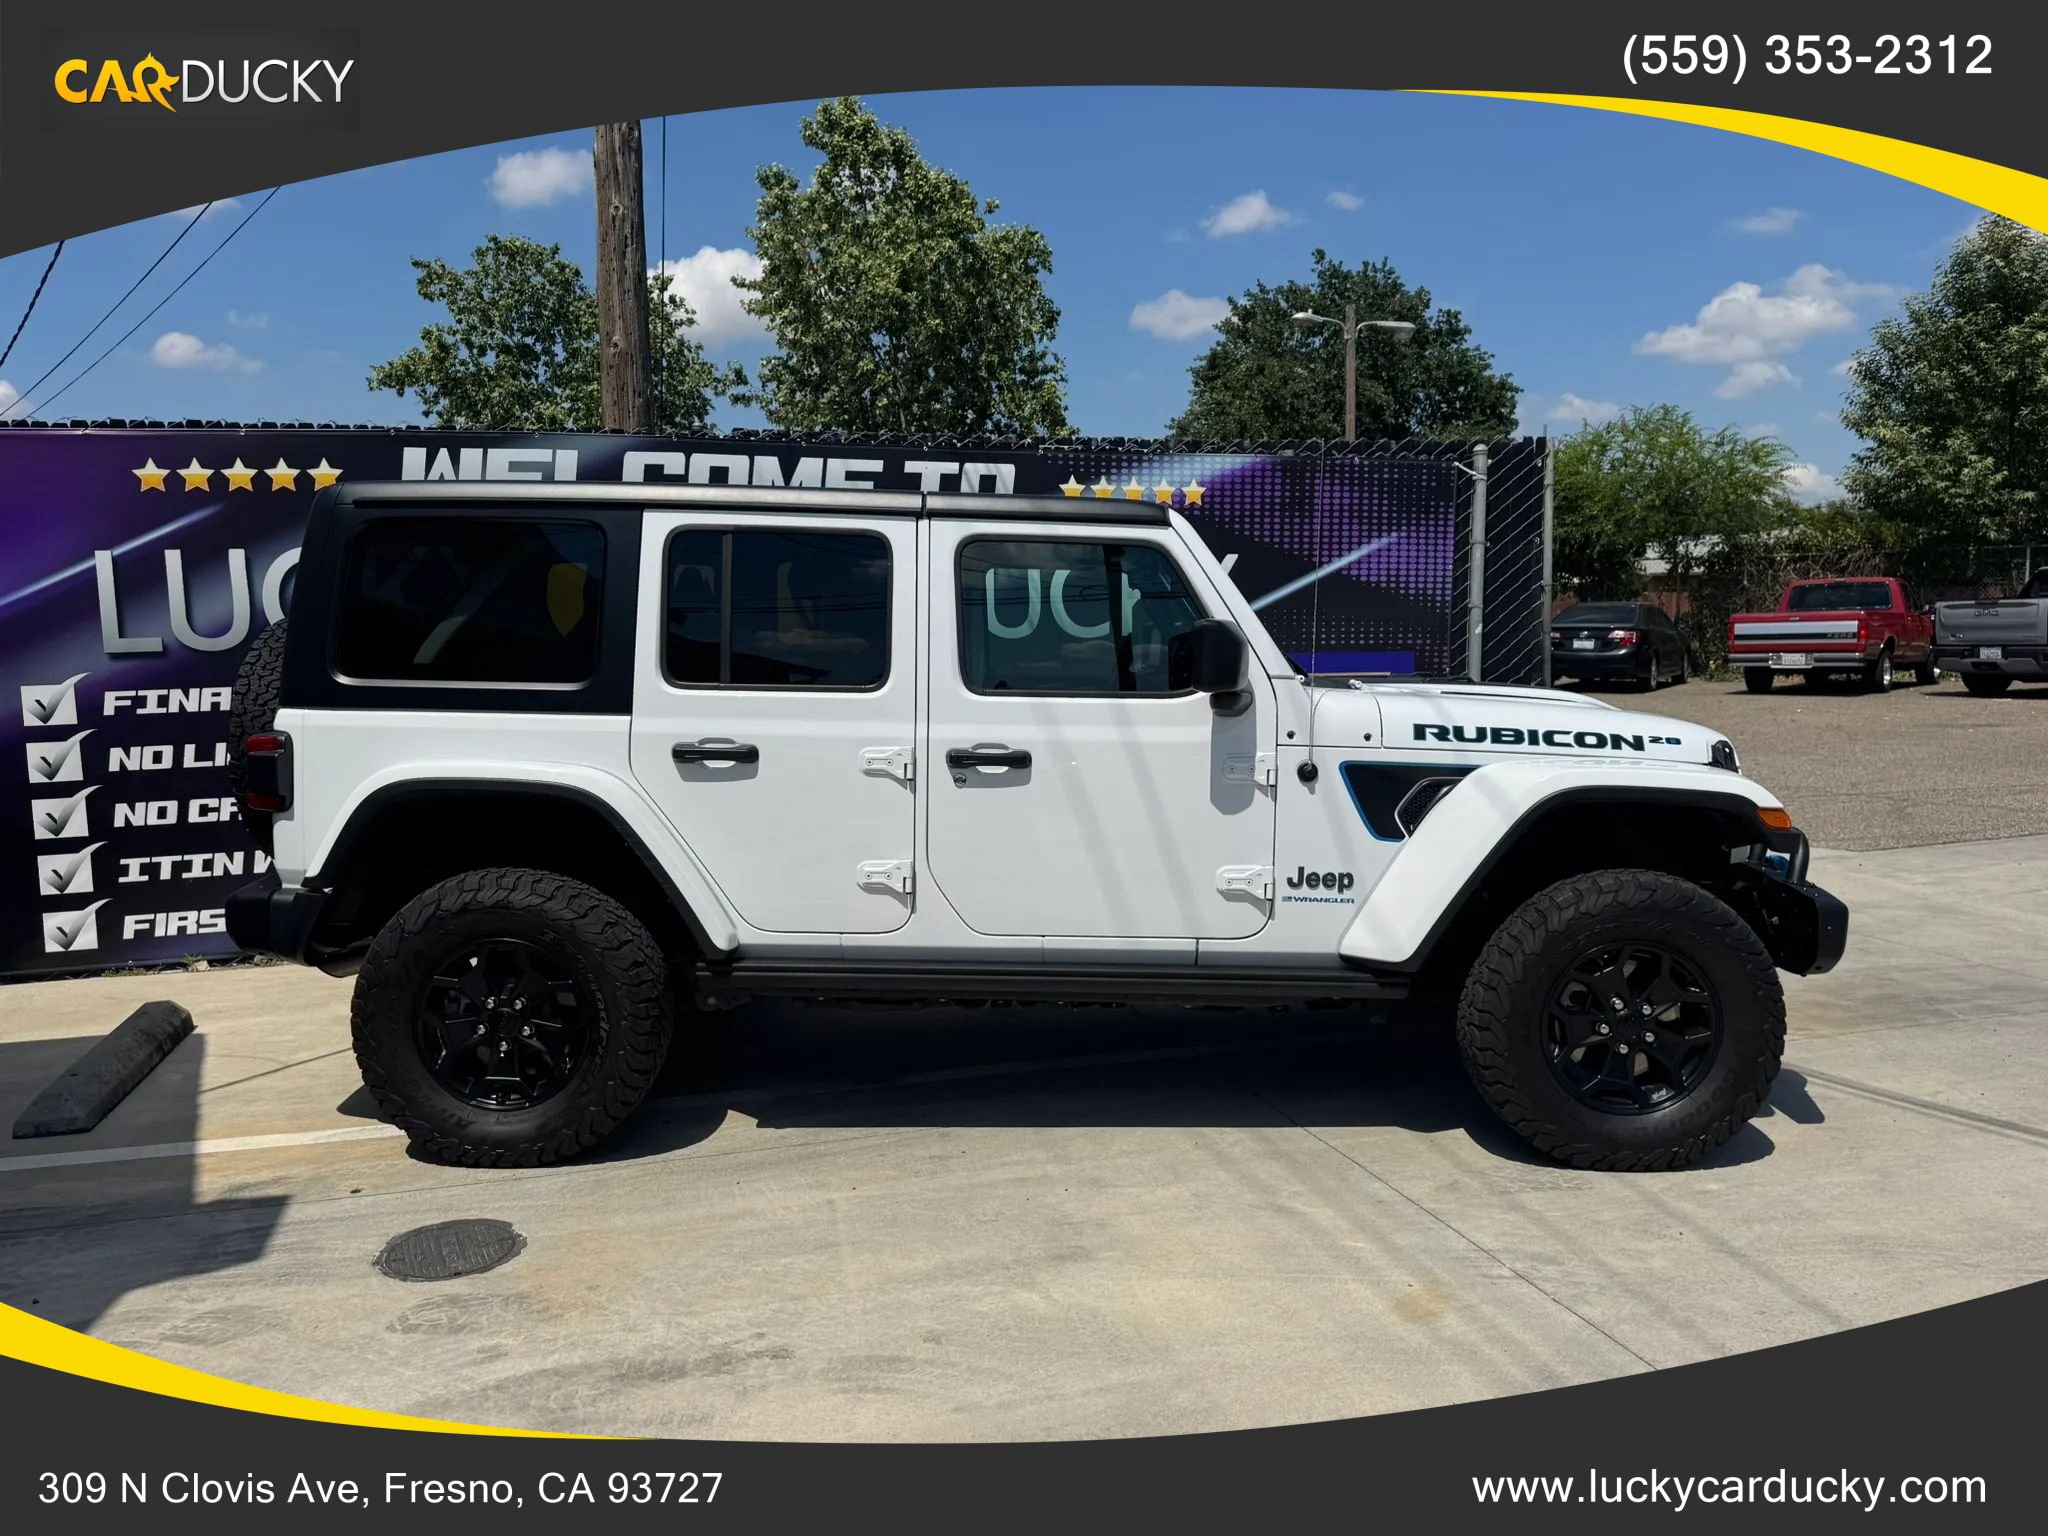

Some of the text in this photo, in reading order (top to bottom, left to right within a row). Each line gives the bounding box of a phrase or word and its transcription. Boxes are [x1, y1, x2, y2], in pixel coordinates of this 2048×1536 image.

[1413, 723, 1646, 752] RUBICON
[108, 745, 174, 772] NO
[113, 800, 178, 828] NO
[118, 851, 244, 884] ITIN
[1286, 866, 1354, 898] Jeep
[1292, 895, 1355, 904] WRANGLER
[122, 908, 227, 940] FIRS
